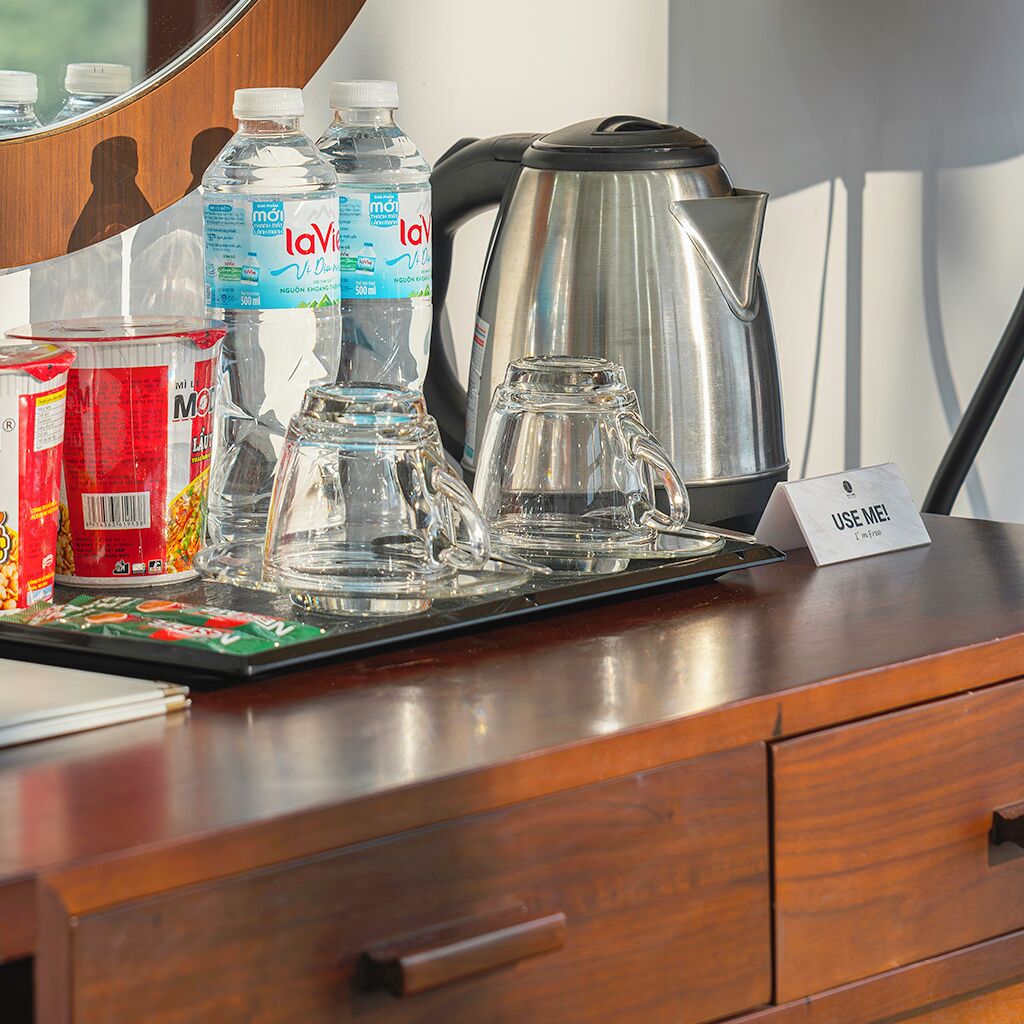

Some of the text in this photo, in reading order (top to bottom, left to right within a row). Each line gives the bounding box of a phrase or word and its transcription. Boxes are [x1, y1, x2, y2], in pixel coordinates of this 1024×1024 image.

[370, 199, 398, 213] mới
[253, 207, 283, 222] mới
[356, 286, 367, 295] 500
[240, 297, 251, 305] 500
[175, 379, 187, 390] MÌ
[831, 504, 891, 531] USE ME!
